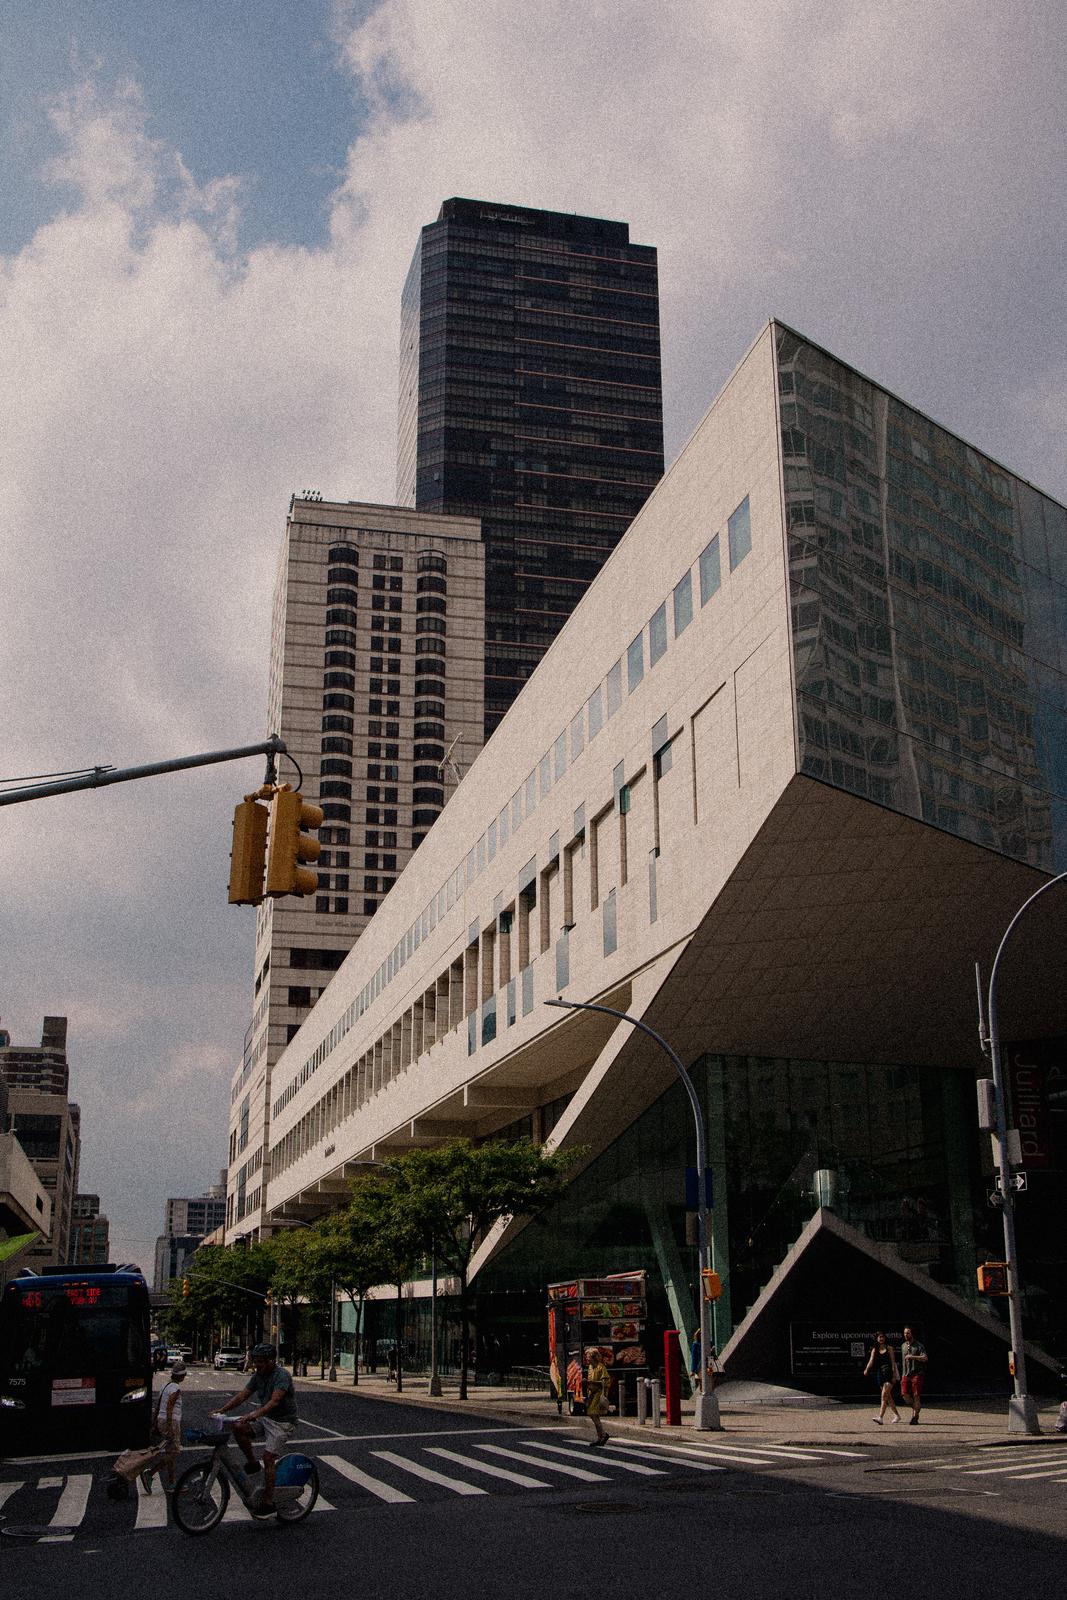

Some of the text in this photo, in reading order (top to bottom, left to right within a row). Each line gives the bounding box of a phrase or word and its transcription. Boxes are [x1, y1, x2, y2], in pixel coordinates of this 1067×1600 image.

[1014, 1054, 1046, 1157] Juilliard
[85, 1287, 101, 1296] SIDE
[812, 1331, 839, 1342] Explore
